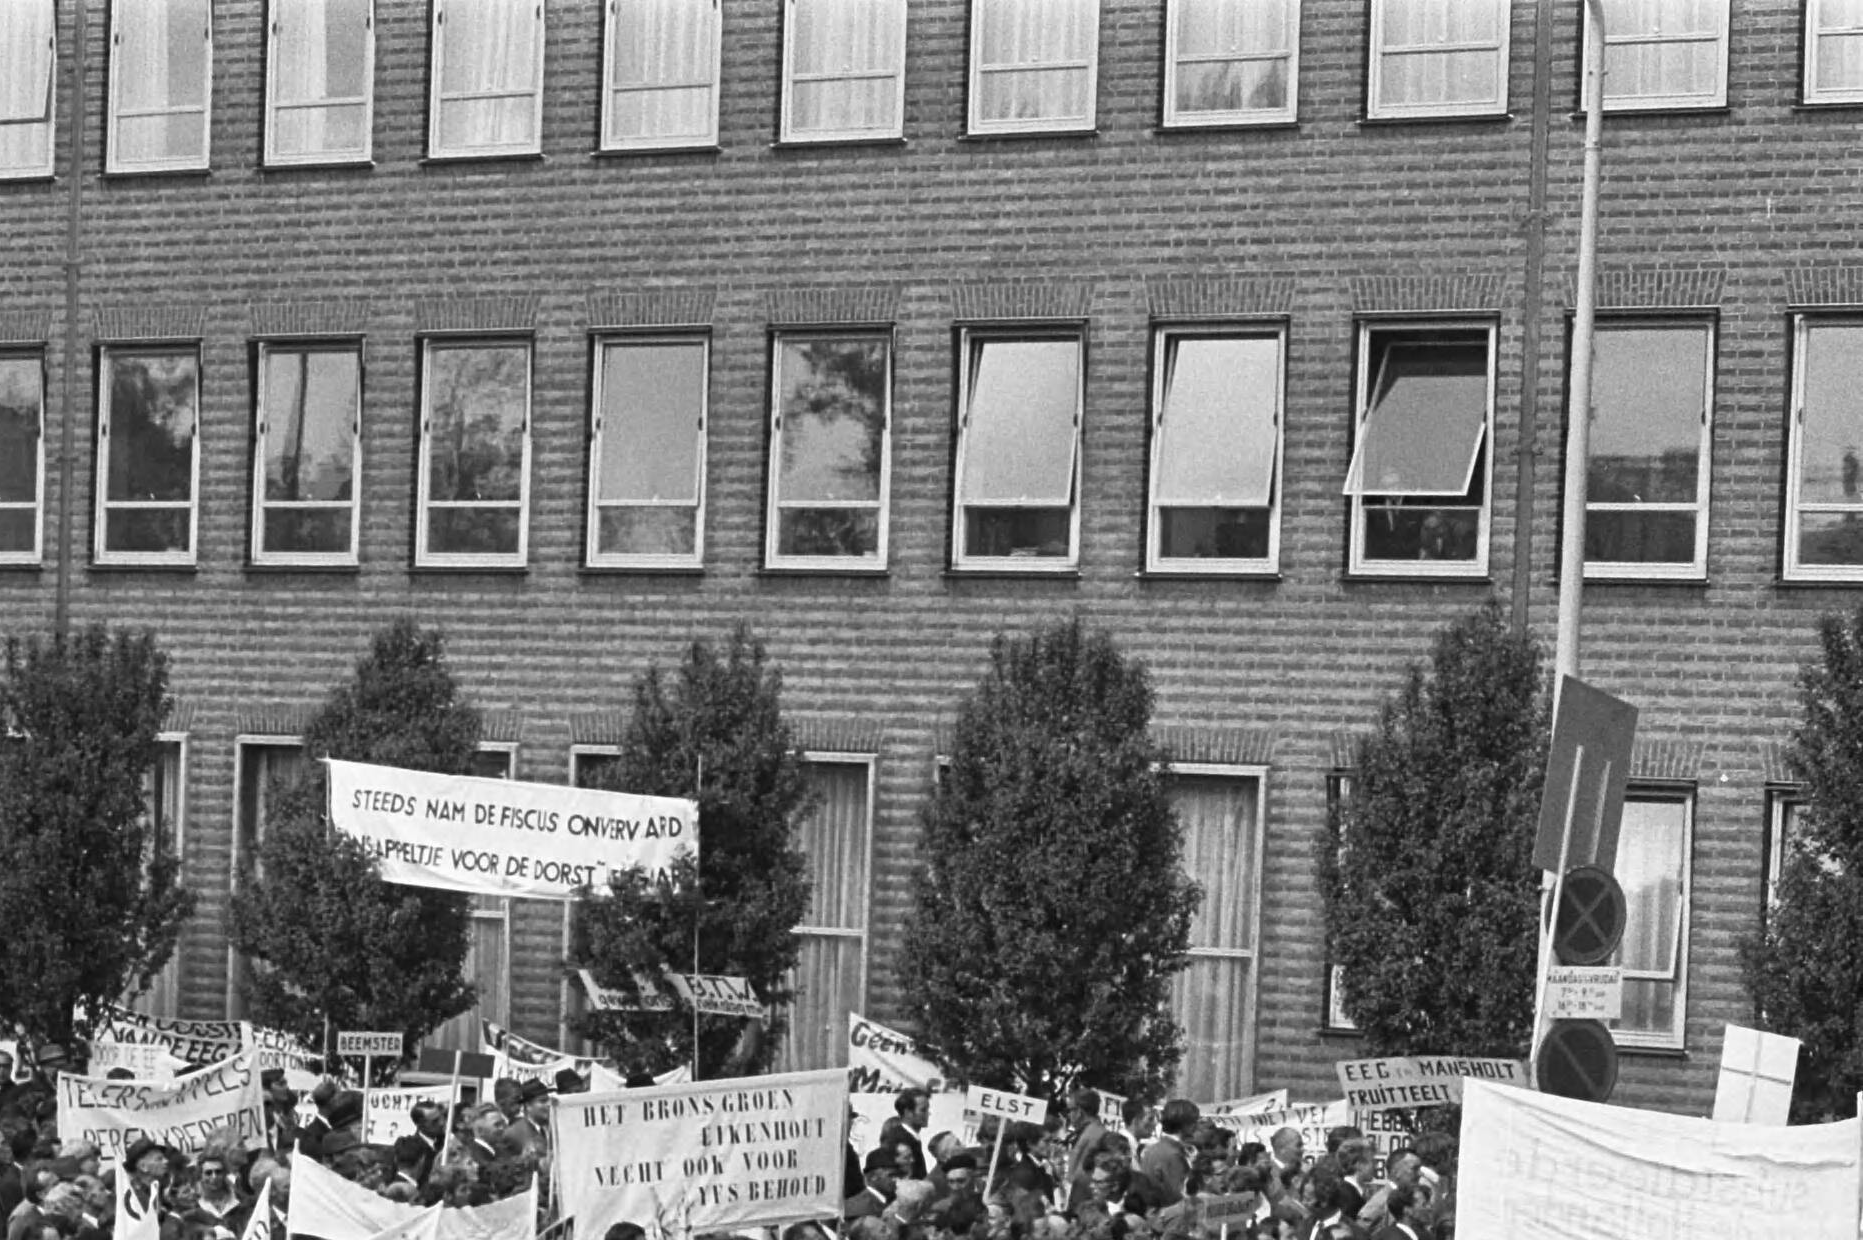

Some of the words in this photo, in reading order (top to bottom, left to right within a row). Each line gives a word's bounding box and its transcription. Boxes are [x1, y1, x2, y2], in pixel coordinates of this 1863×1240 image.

[352, 788, 417, 817] STEEDS
[425, 798, 465, 823] NAM
[474, 803, 496, 826] DE
[499, 806, 560, 834] FISCUS
[451, 849, 499, 875] VOOR
[505, 855, 529, 878] DE
[339, 1035, 401, 1051] BEEMSTER
[1418, 1058, 1516, 1081] MANSHOLT
[583, 1103, 627, 1128] HET
[980, 1092, 1034, 1117] ELST
[701, 1117, 826, 1148] EIKENHOUT
[594, 1160, 665, 1187] VECHT
[682, 1154, 725, 1179] OOK
[742, 1148, 799, 1172] VOOR
[748, 1174, 827, 1202] BEHOUD
